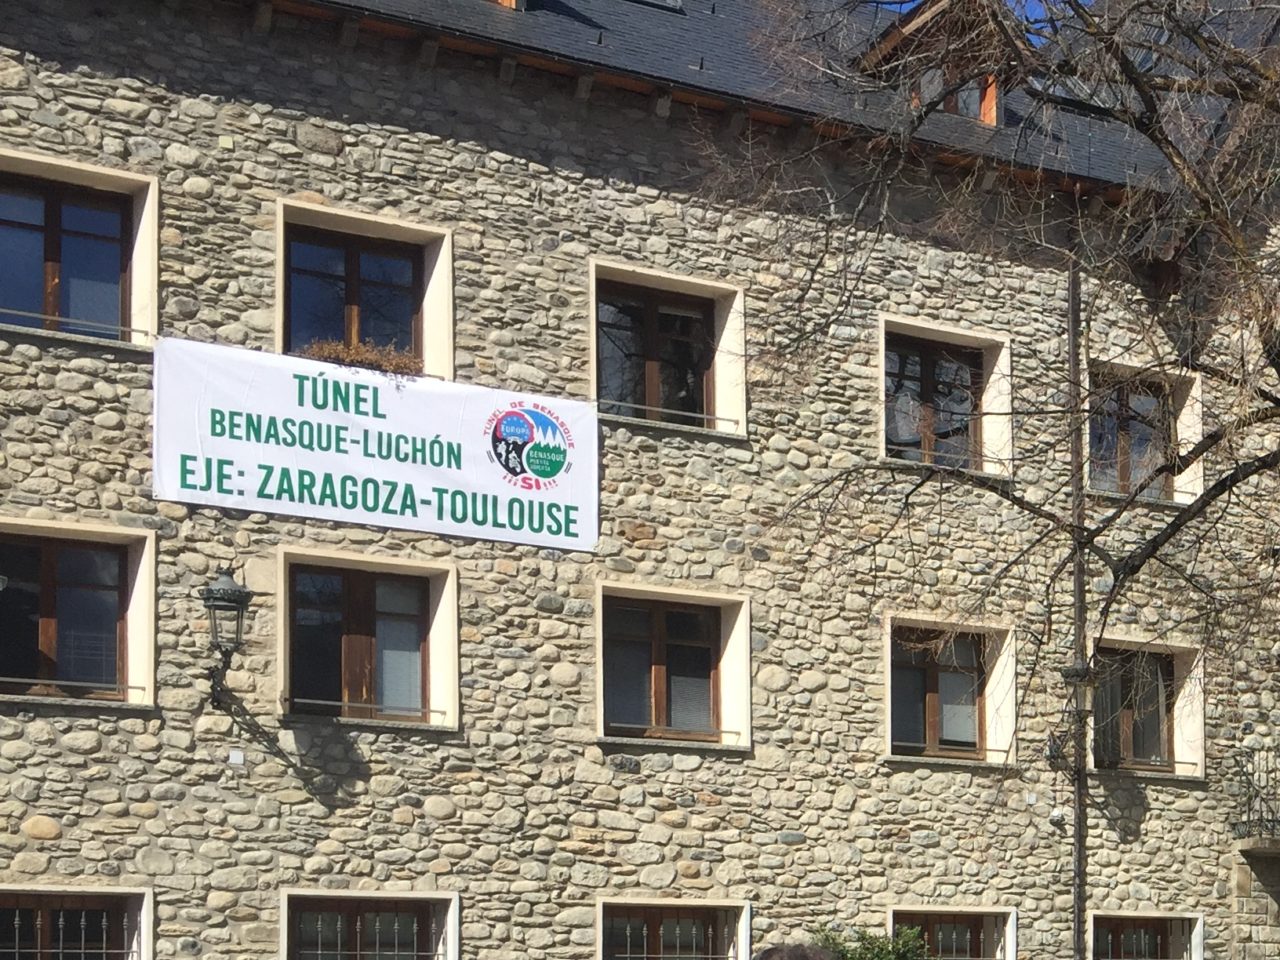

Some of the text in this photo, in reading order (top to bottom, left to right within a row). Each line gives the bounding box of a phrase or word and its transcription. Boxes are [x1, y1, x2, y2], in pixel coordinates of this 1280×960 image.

[293, 371, 387, 419] TÚNEL
[210, 408, 462, 470] BENASQUE-LUCHÓN
[483, 401, 575, 450] TUNEL DE BENASQUE
[529, 450, 564, 462] BENASQUE
[180, 454, 579, 538] EJE: ZARAGOZA-TOULOUSE
